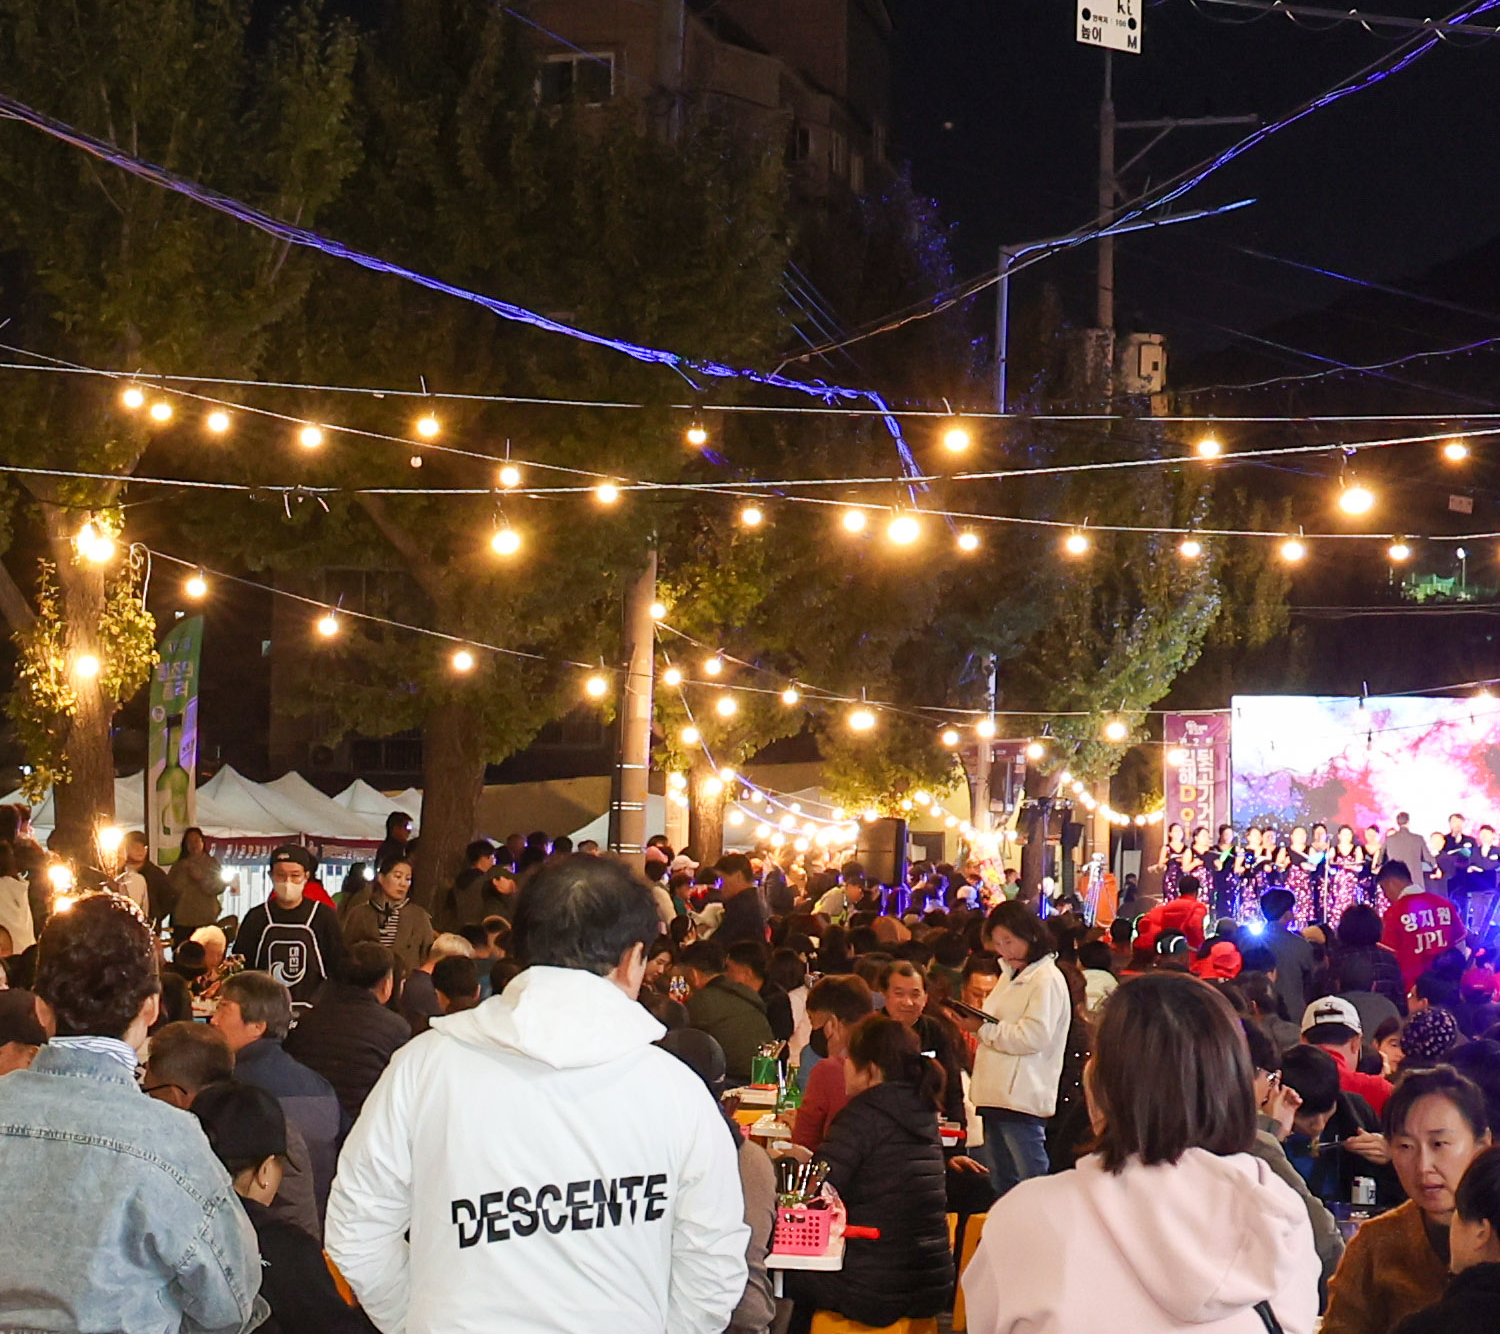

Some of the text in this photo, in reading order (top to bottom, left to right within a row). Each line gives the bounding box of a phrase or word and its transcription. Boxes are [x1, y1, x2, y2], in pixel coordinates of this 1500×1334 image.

[1127, 34, 1138, 49] M
[1400, 907, 1451, 933] 양지원
[1414, 929, 1448, 955] JPL
[451, 1172, 668, 1249] DESCENTE
